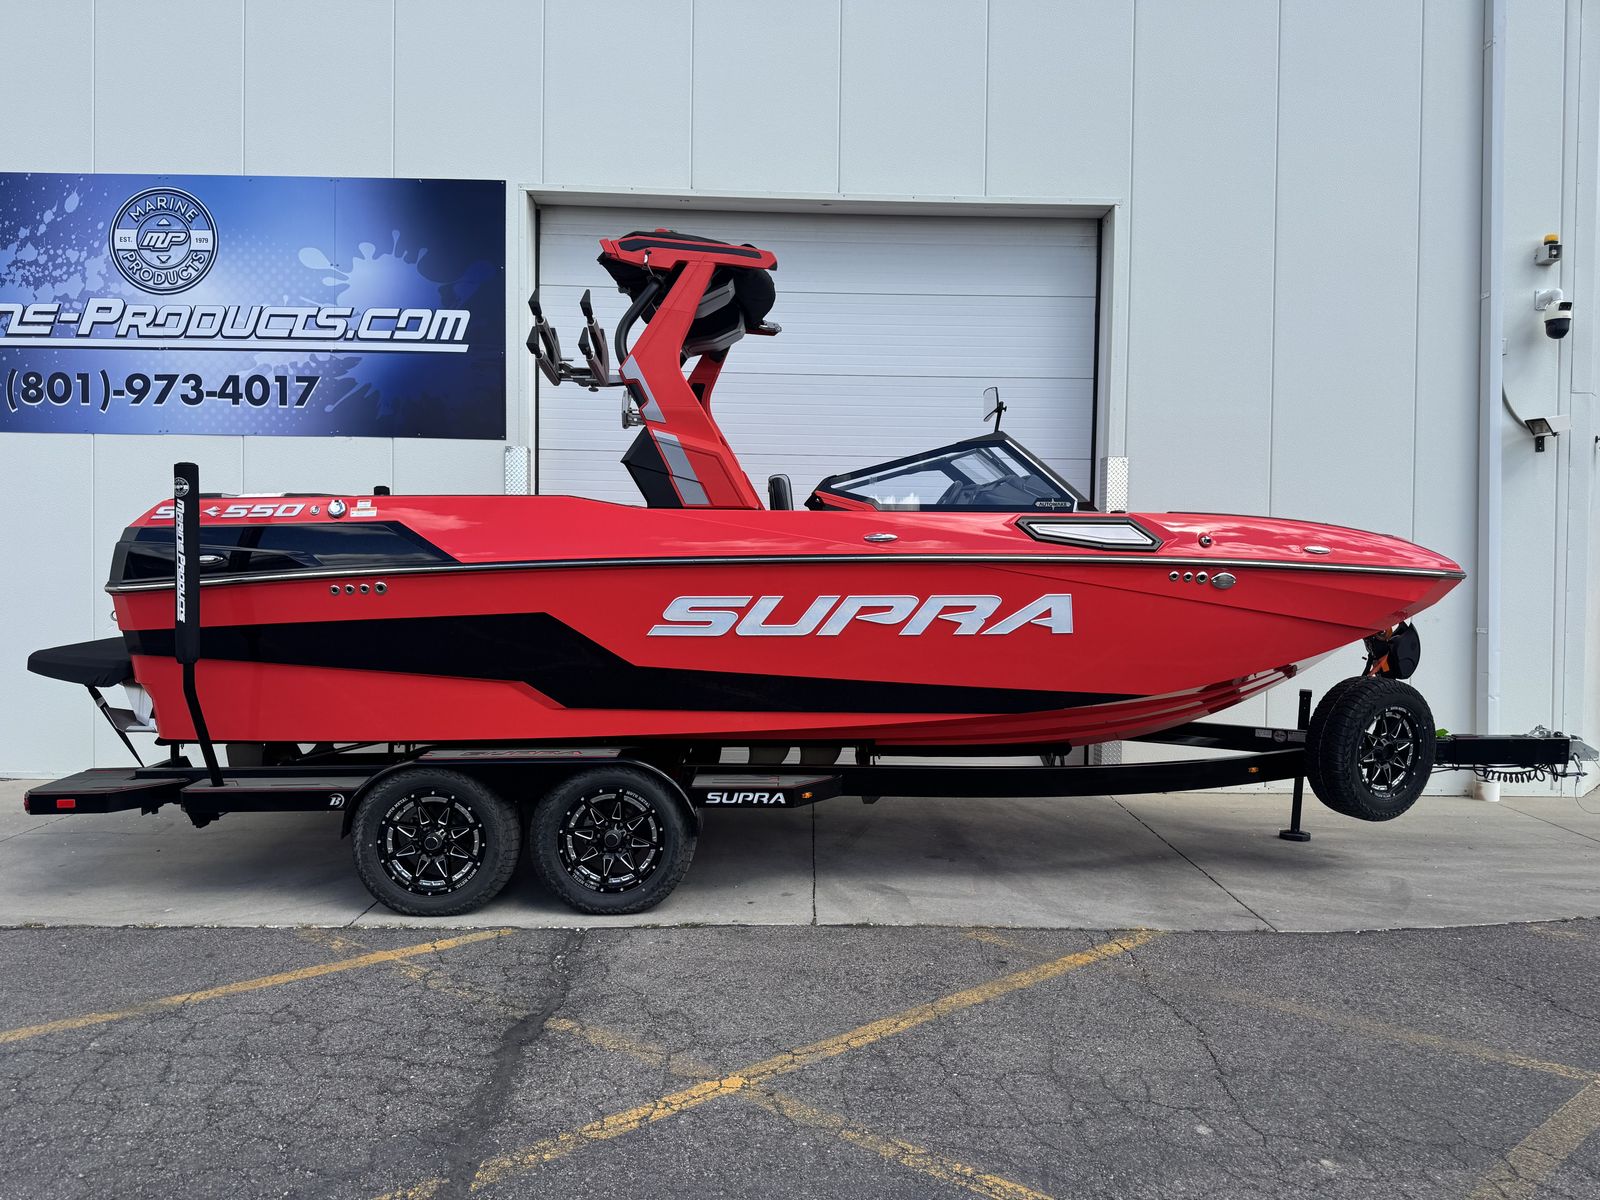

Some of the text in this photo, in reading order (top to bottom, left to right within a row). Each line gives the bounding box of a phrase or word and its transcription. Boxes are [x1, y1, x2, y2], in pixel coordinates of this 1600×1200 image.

[129, 196, 199, 222] MARINE
[122, 251, 205, 285] PRODUCTS
[6, 368, 321, 413] (801)-973-4017
[220, 503, 306, 519] 550
[646, 593, 1073, 637] SUPRA
[705, 791, 787, 805] SUPRA
